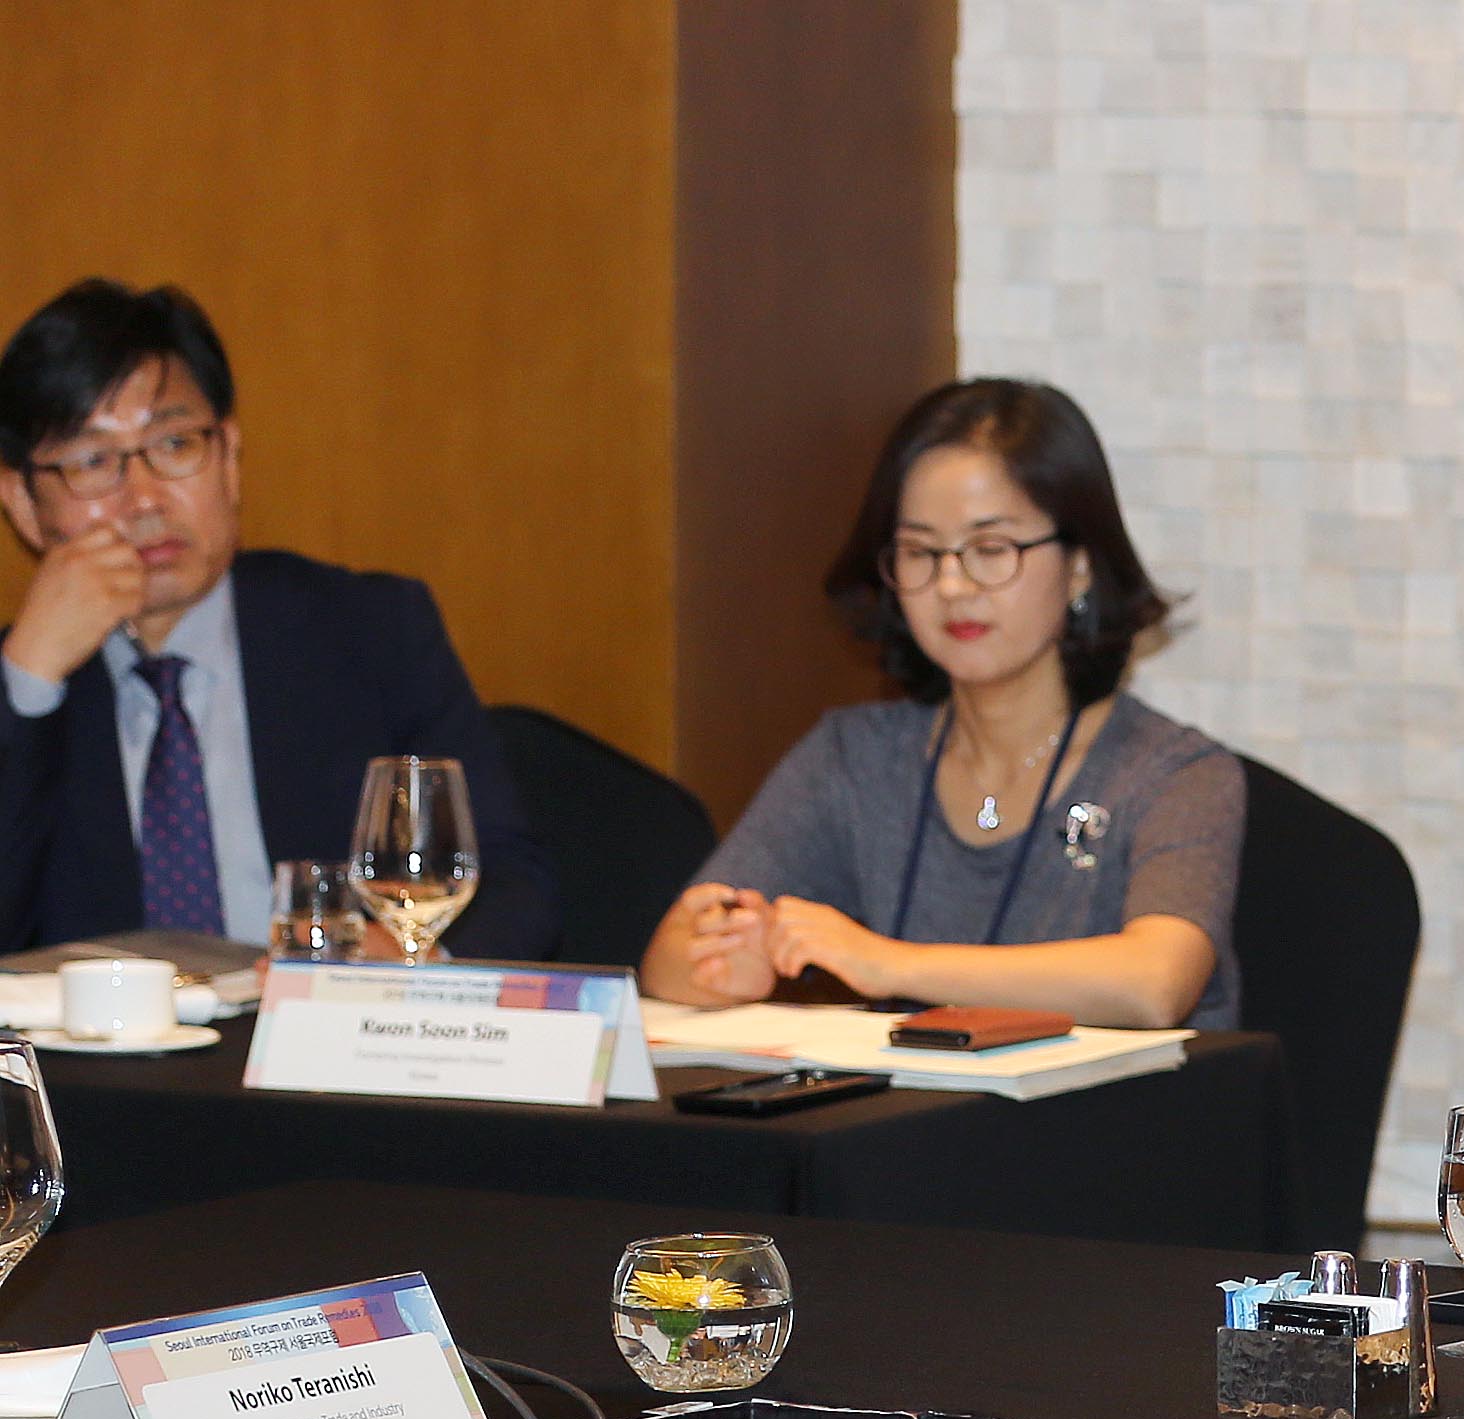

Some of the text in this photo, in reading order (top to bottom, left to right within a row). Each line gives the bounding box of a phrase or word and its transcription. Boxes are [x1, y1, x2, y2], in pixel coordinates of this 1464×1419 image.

[360, 1017, 510, 1041] Kwon Soon Sim
[165, 1337, 192, 1352] Seoul
[193, 1326, 250, 1346] International
[252, 1321, 281, 1336] Forum
[281, 1319, 292, 1331] on
[291, 1315, 319, 1330] Trade
[228, 1345, 254, 1361] 2018
[253, 1338, 289, 1356] 무역구제
[229, 1363, 376, 1412] Noriko Teranishi
[367, 1402, 405, 1418] Industry
